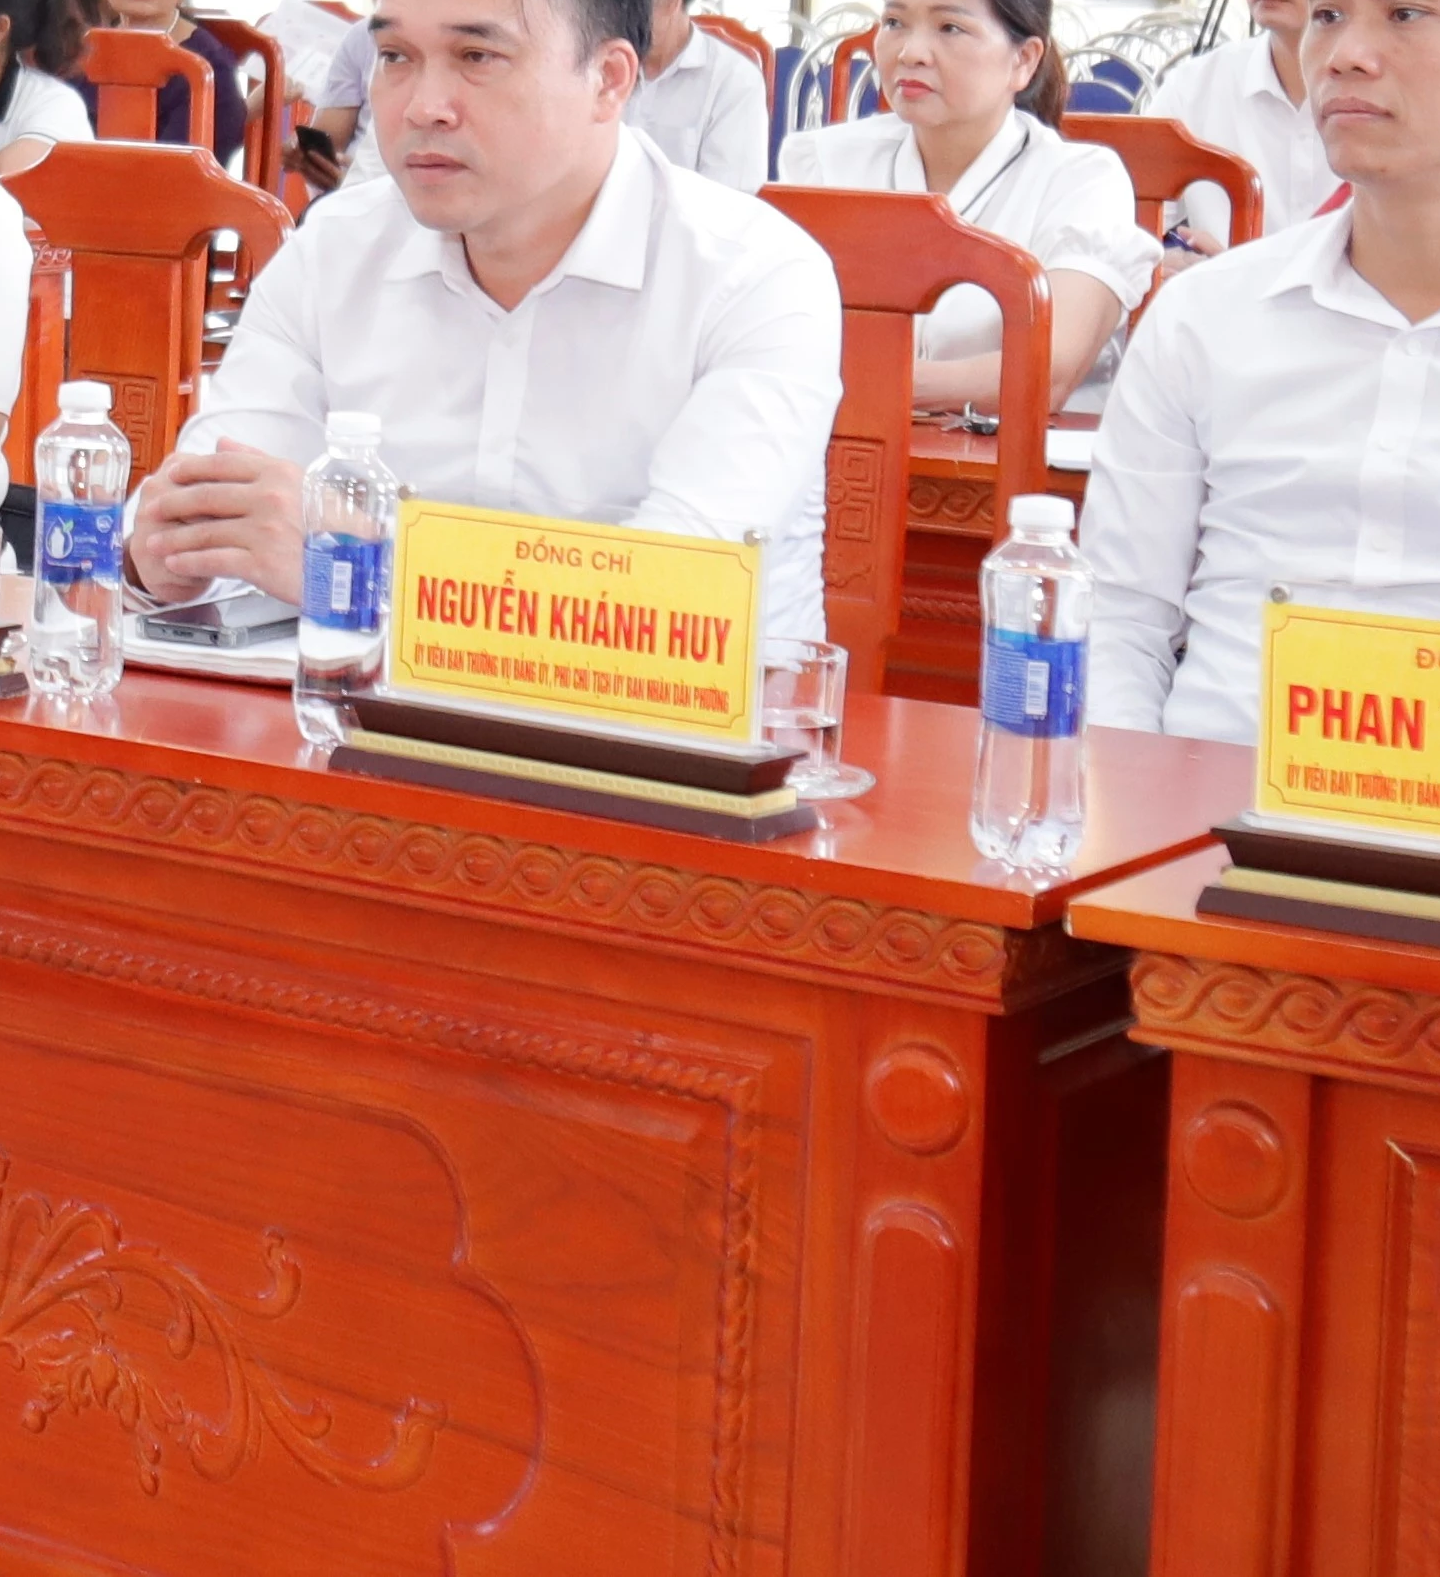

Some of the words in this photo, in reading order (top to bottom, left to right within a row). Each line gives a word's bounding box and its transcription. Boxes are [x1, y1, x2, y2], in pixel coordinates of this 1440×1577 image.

[516, 535, 583, 568] ĐỒNG
[591, 550, 632, 574] CHÍ
[418, 570, 539, 638] NGUYỄN
[550, 590, 658, 655] KHÁNH
[668, 610, 732, 666] HUY
[427, 641, 445, 668] VIÊN
[448, 648, 464, 671] BAN
[467, 648, 498, 677] THƯỜNG
[514, 653, 536, 683] ĐẢNG
[554, 662, 570, 688] PHÓ
[573, 662, 589, 691] CHỦ
[593, 670, 611, 699] TỊCH
[626, 676, 646, 700] BAN
[647, 677, 671, 705] NHÂN
[673, 679, 691, 708] DÂN
[693, 682, 729, 714] PHƯỜNG
[1287, 683, 1426, 752] PHAN
[1330, 769, 1352, 797] BAN
